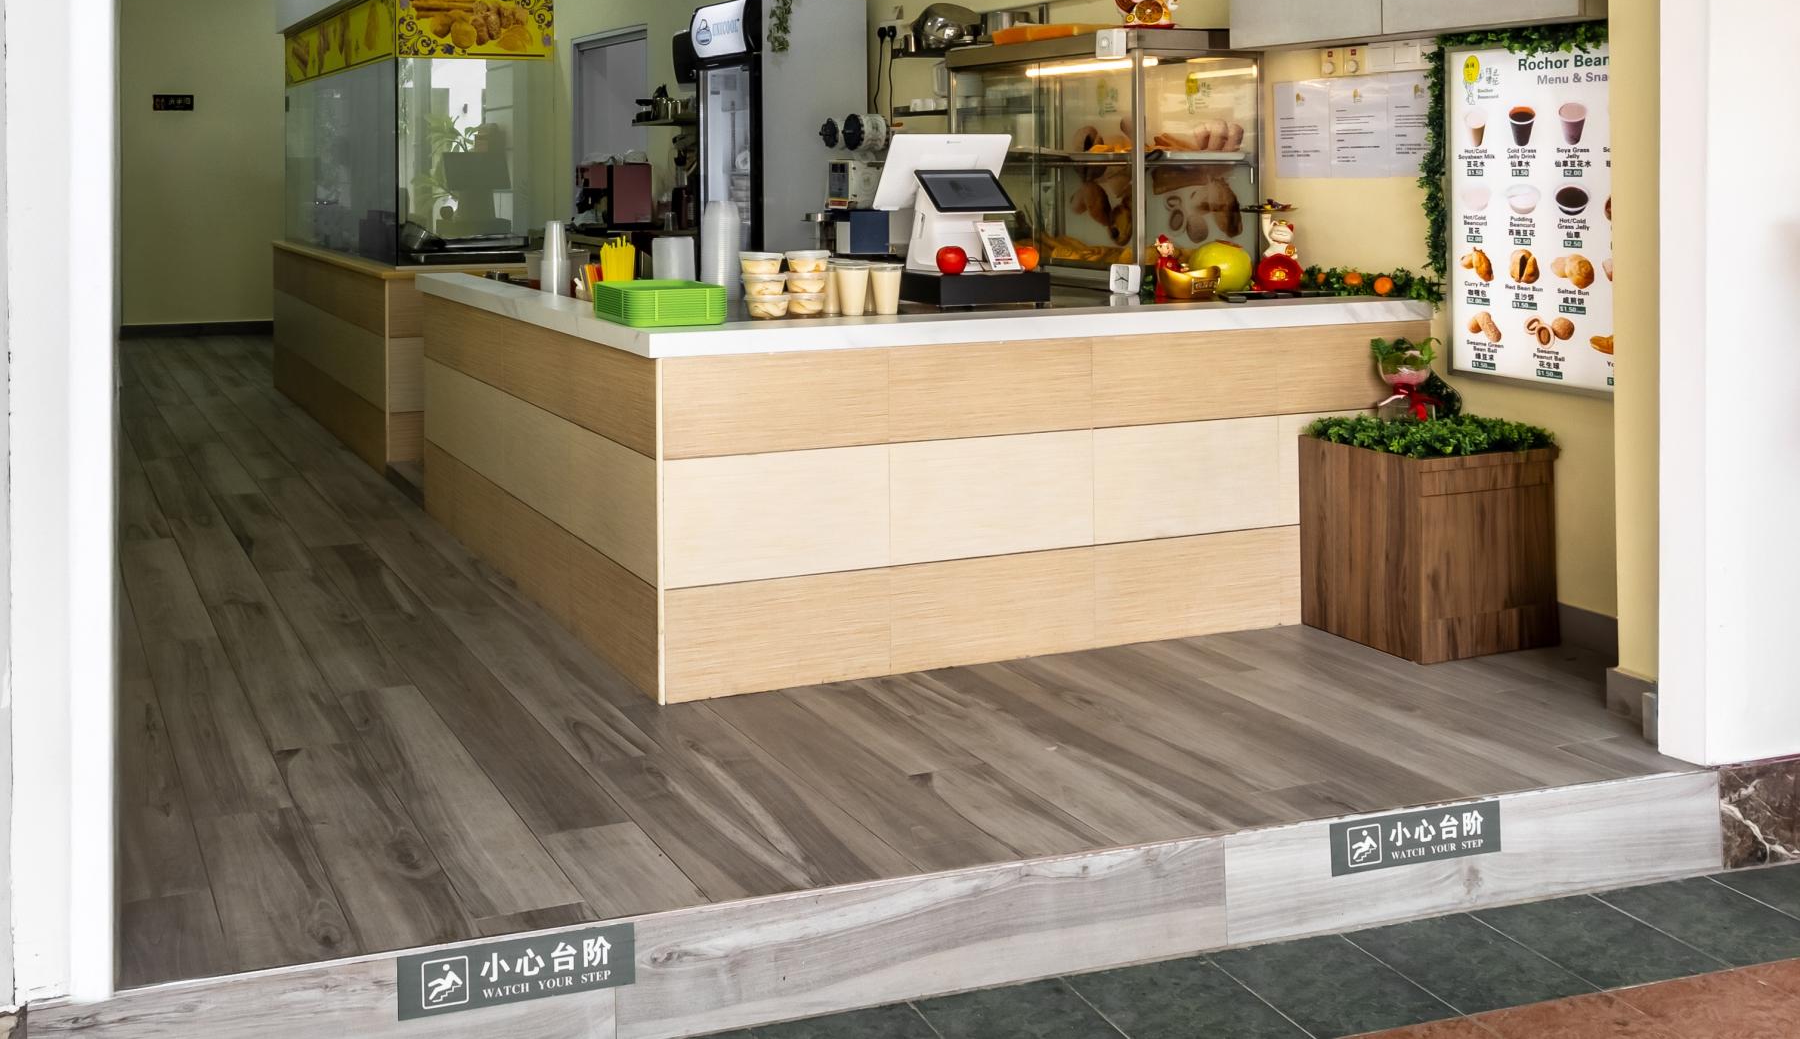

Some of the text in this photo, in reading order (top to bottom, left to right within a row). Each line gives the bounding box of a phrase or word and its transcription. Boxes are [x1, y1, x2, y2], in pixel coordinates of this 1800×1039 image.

[1518, 57, 1570, 71] Rochor
[1537, 74, 1569, 86] Menu
[1572, 72, 1582, 83] &
[1389, 810, 1484, 847] 小心台阶
[1391, 838, 1484, 861] WATCH YOUR STEP
[480, 936, 612, 983] 小心台阶
[482, 969, 612, 1000] WATCH YOUR STEP
